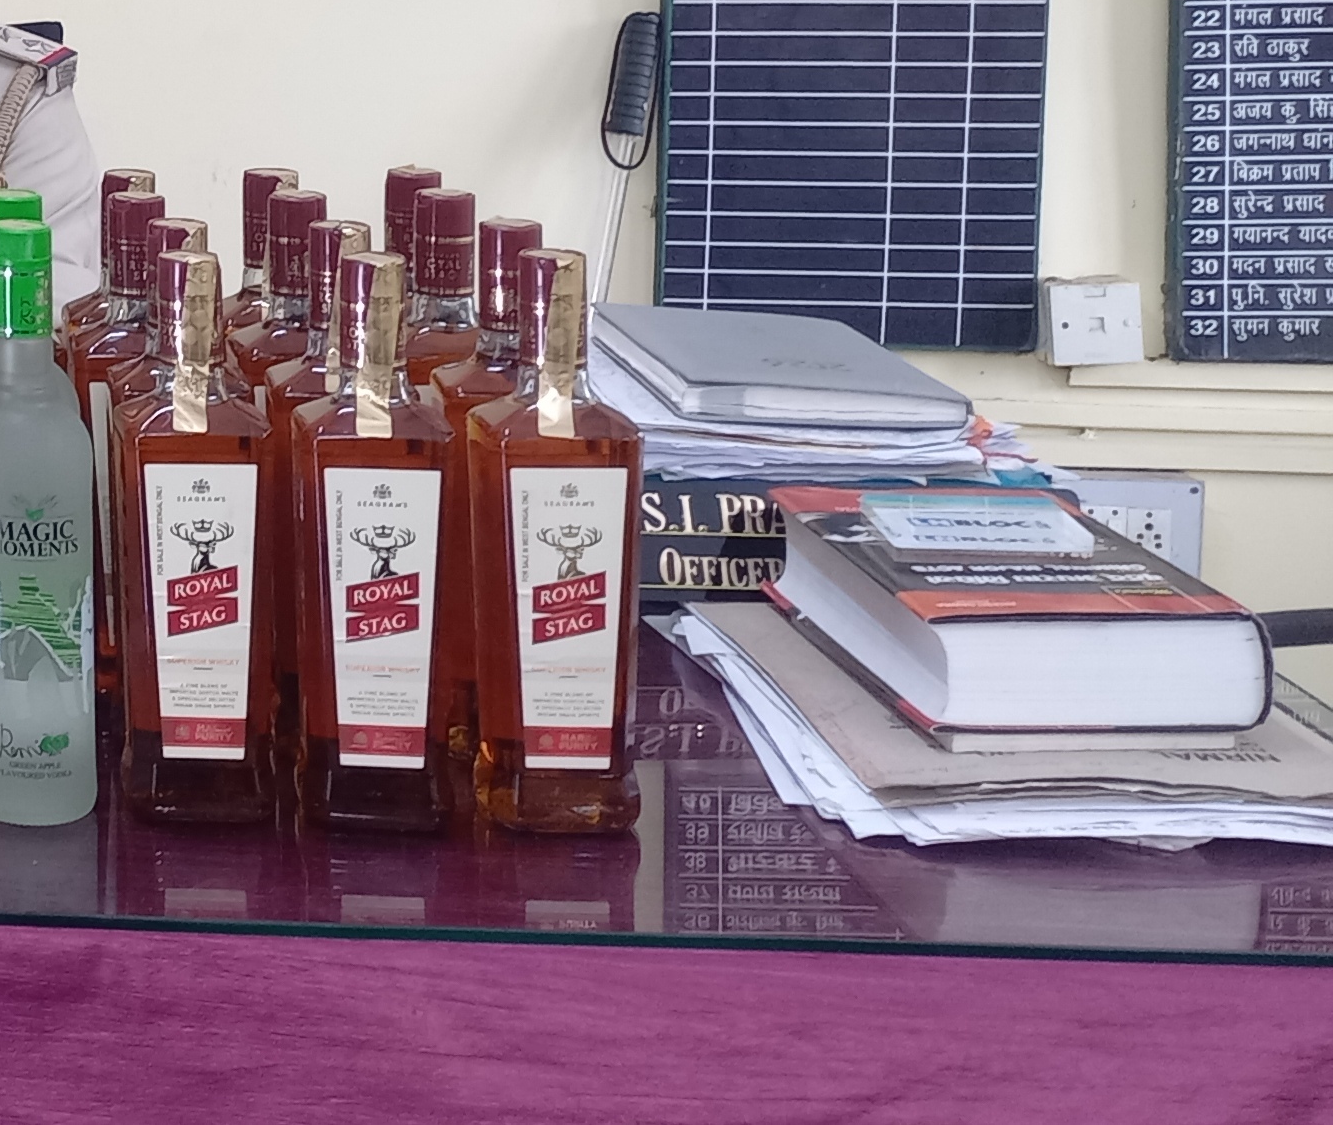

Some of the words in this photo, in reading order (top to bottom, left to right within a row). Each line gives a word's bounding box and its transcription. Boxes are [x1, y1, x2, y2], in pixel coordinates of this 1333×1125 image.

[1192, 10, 1221, 27] 22
[1281, 7, 1326, 25] प्रसाद
[1192, 42, 1221, 58] 23
[1233, 34, 1260, 57] रवि
[1266, 38, 1311, 61] ठाकुर
[1192, 104, 1220, 121] 25
[1233, 101, 1273, 119] अजय
[1191, 166, 1220, 182] 27
[1282, 162, 1321, 180] प्रताप
[1191, 196, 1219, 213] 28
[1283, 194, 1325, 212] प्रसाद
[1190, 258, 1219, 275] 30
[1233, 257, 1266, 274] मदन
[1190, 289, 1216, 306] 31
[1278, 283, 1317, 309] सुरेश
[1189, 319, 1219, 336] 32
[1232, 318, 1269, 341] सुमन
[1278, 318, 1320, 341] कुमार
[641, 492, 709, 532] S.I.
[173, 572, 232, 599] ROYAL
[353, 578, 413, 605] ROYAL
[540, 578, 600, 606] ROYAL
[179, 606, 226, 630] STAG
[358, 612, 406, 636] STAG
[544, 613, 593, 637] STAG
